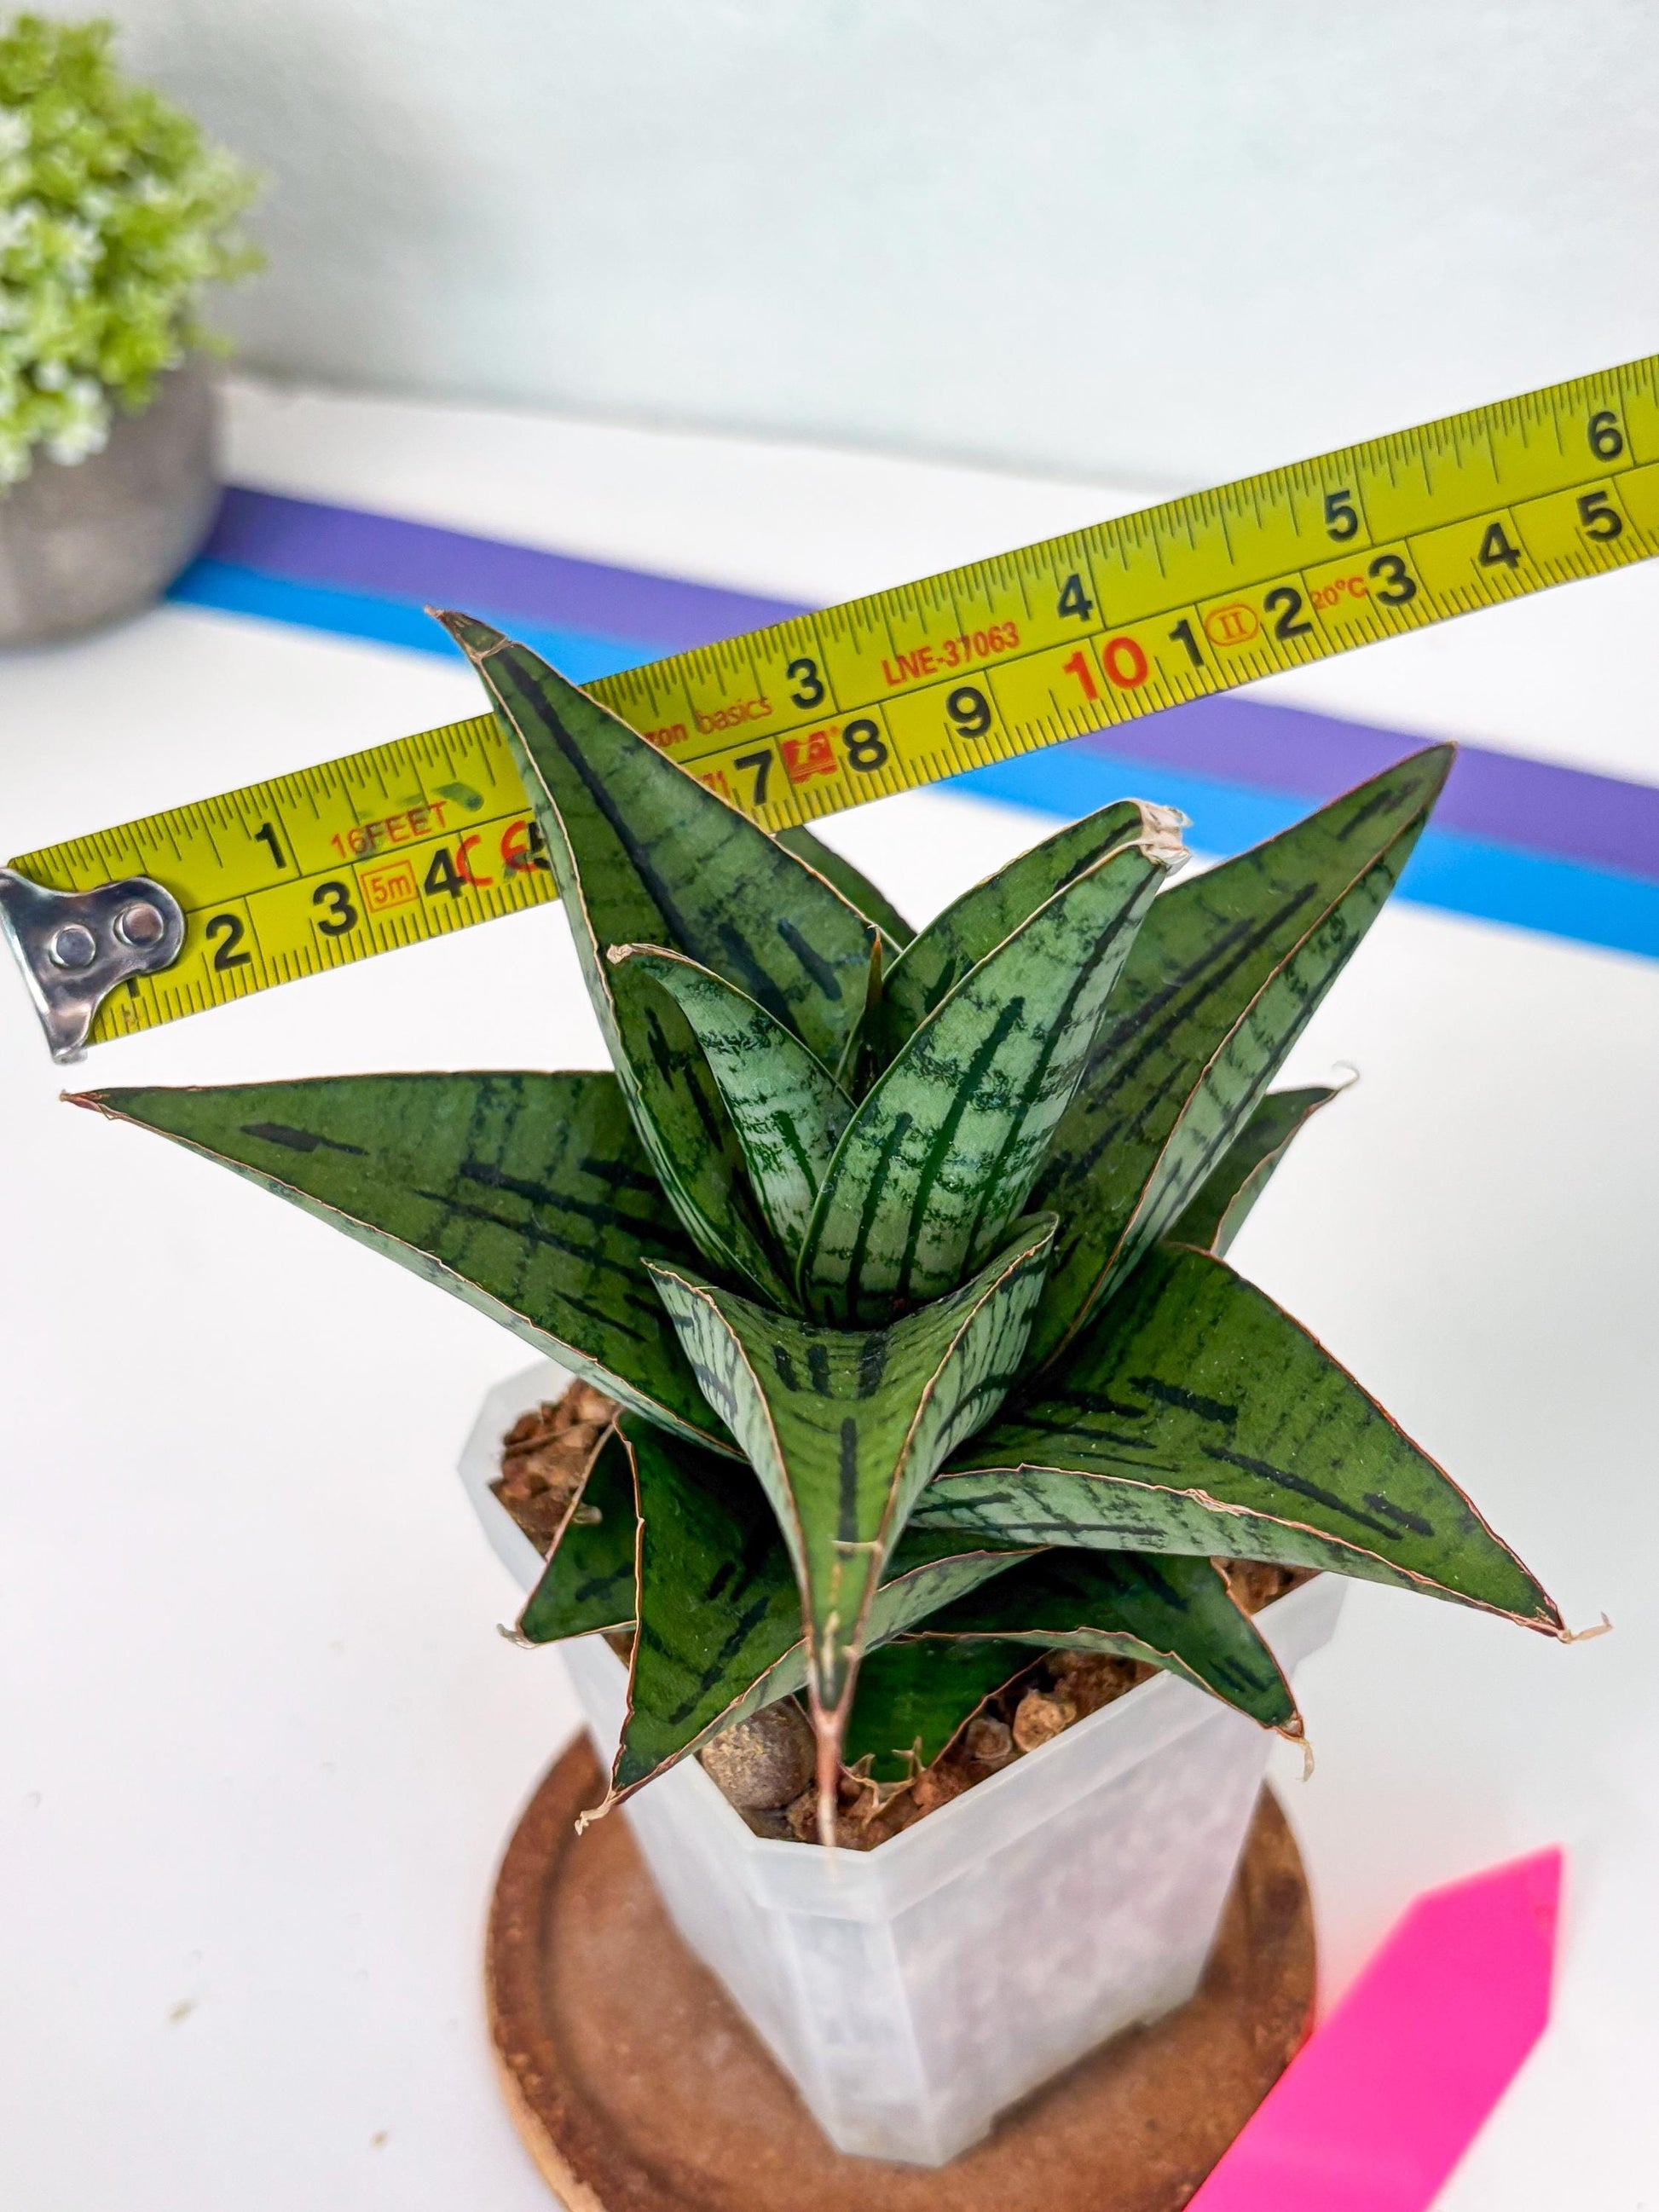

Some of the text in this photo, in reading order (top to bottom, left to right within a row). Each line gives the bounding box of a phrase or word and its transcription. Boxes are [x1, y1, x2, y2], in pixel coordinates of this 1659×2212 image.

[1587, 410, 1625, 463] 6
[1323, 489, 1360, 543] 5
[1577, 490, 1623, 543] 5
[1477, 520, 1522, 571] 4
[1055, 572, 1095, 622] 4
[1367, 554, 1418, 607] 3
[1263, 586, 1313, 642] 2
[882, 621, 1020, 685] LNE-37063
[1063, 636, 1148, 702] 10
[1169, 620, 1205, 668] 1
[787, 657, 824, 710] 3
[693, 697, 772, 735] basics
[945, 686, 991, 739] 9
[842, 719, 888, 772] 8
[734, 749, 772, 806] 7
[255, 822, 285, 869] 1
[370, 873, 412, 904] 5m
[424, 847, 466, 899] 4
[311, 881, 358, 936] 3
[205, 915, 251, 972] 2
